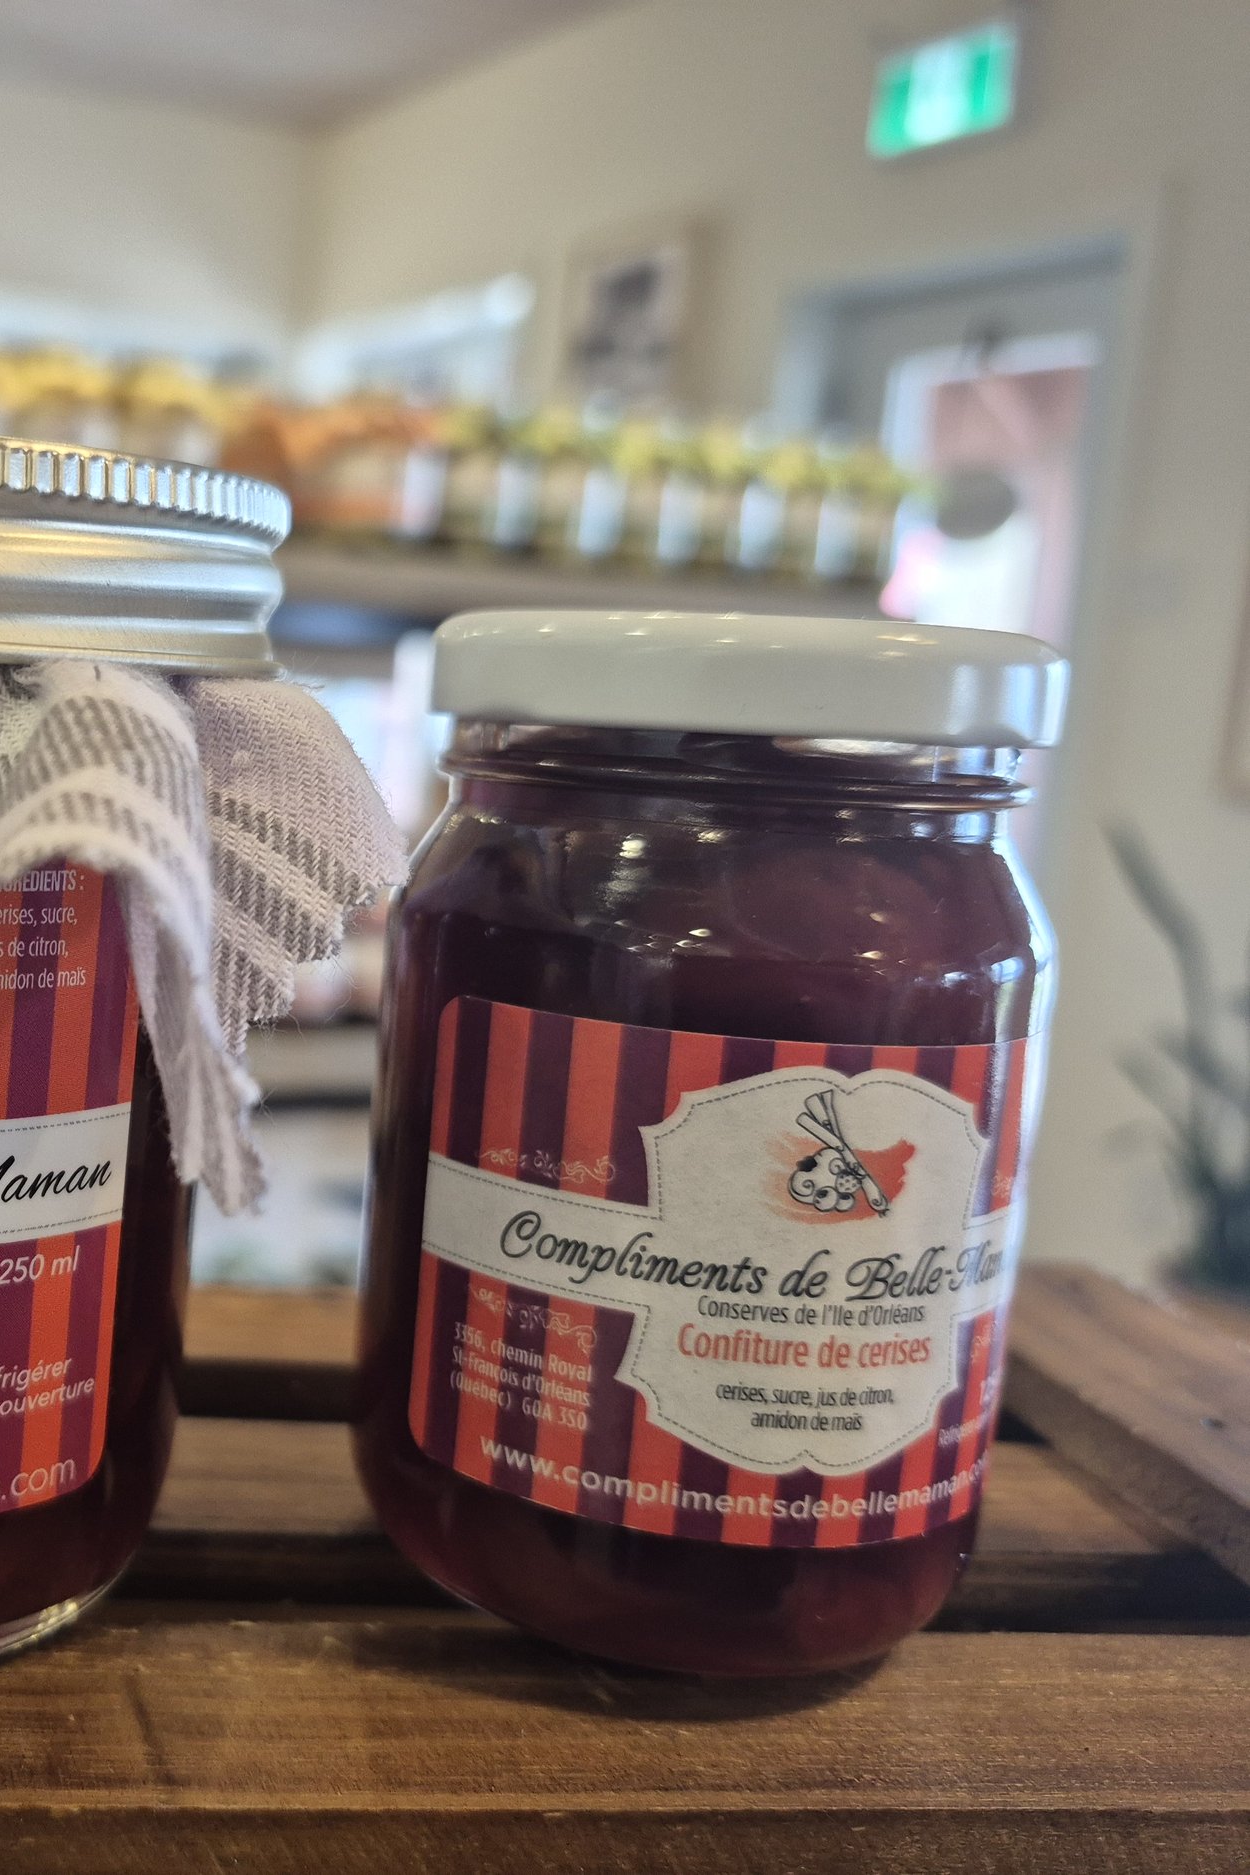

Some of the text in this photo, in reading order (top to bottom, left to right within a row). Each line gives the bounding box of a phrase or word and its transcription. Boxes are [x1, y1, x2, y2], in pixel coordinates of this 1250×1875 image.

[41, 906, 78, 926] sucre,
[8, 937, 25, 957] de
[29, 936, 69, 959] citron,
[38, 968, 54, 988] de
[57, 966, 86, 987] maïs
[50, 1245, 80, 1277] ml
[500, 1210, 767, 1294] Compliments
[778, 1249, 830, 1299] de
[698, 1294, 789, 1324] Conserves
[794, 1303, 816, 1326] de
[858, 1303, 925, 1327] d'Orléans
[491, 1338, 543, 1370] chemin
[548, 1354, 592, 1383] Royal
[677, 1322, 932, 1369] Confiture de cerises
[452, 1346, 591, 1408] St-François d'Orléans
[716, 1382, 768, 1405] cerises,
[771, 1388, 813, 1406] sucre,
[815, 1387, 837, 1408] jus
[839, 1387, 856, 1406] de
[751, 1409, 807, 1431] amidon
[810, 1412, 829, 1431] de
